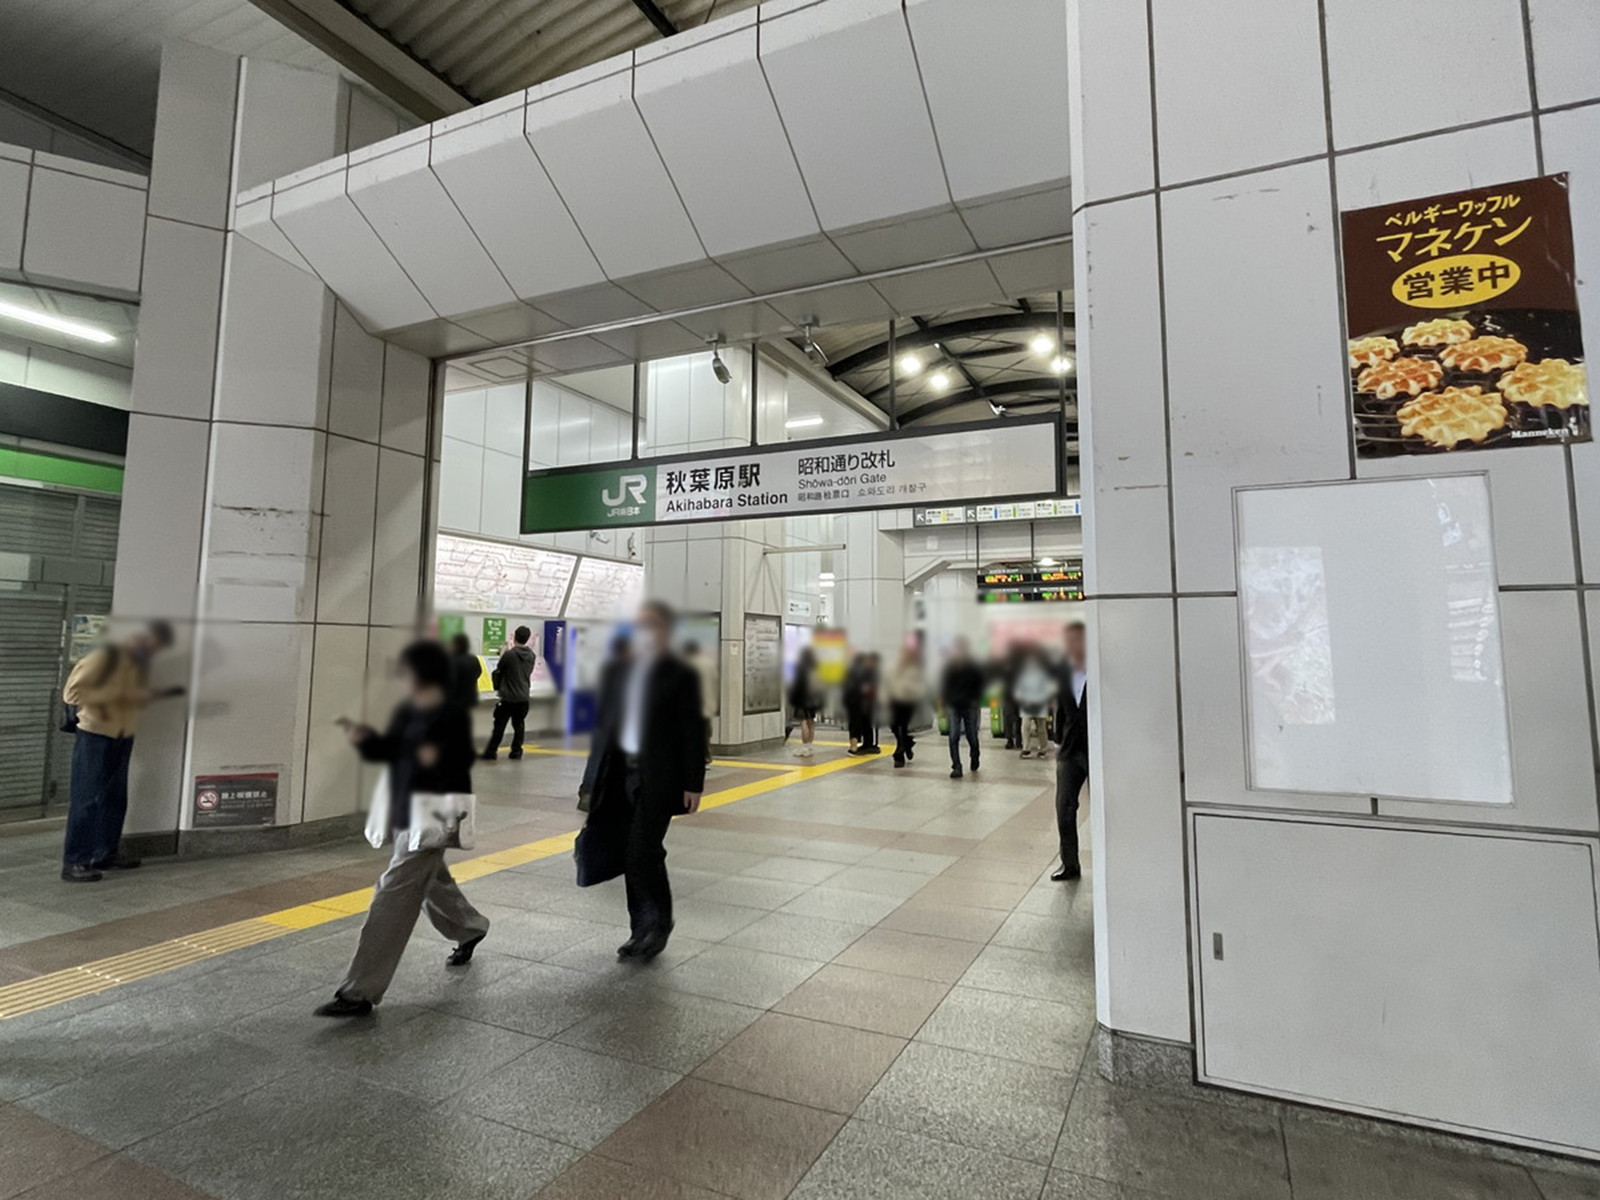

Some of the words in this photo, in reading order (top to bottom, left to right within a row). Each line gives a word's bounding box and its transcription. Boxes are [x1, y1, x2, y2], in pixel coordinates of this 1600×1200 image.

[1385, 194, 1521, 226] ベルギーワッフル
[1376, 216, 1533, 262] マネケン
[1402, 261, 1510, 300] 営業中
[798, 449, 895, 475] 昭和通り改札
[602, 474, 647, 506] JR
[666, 463, 760, 495] 秋葉原駅
[860, 473, 887, 484] Gate
[666, 497, 733, 512] Akihabara
[737, 492, 788, 506] Station
